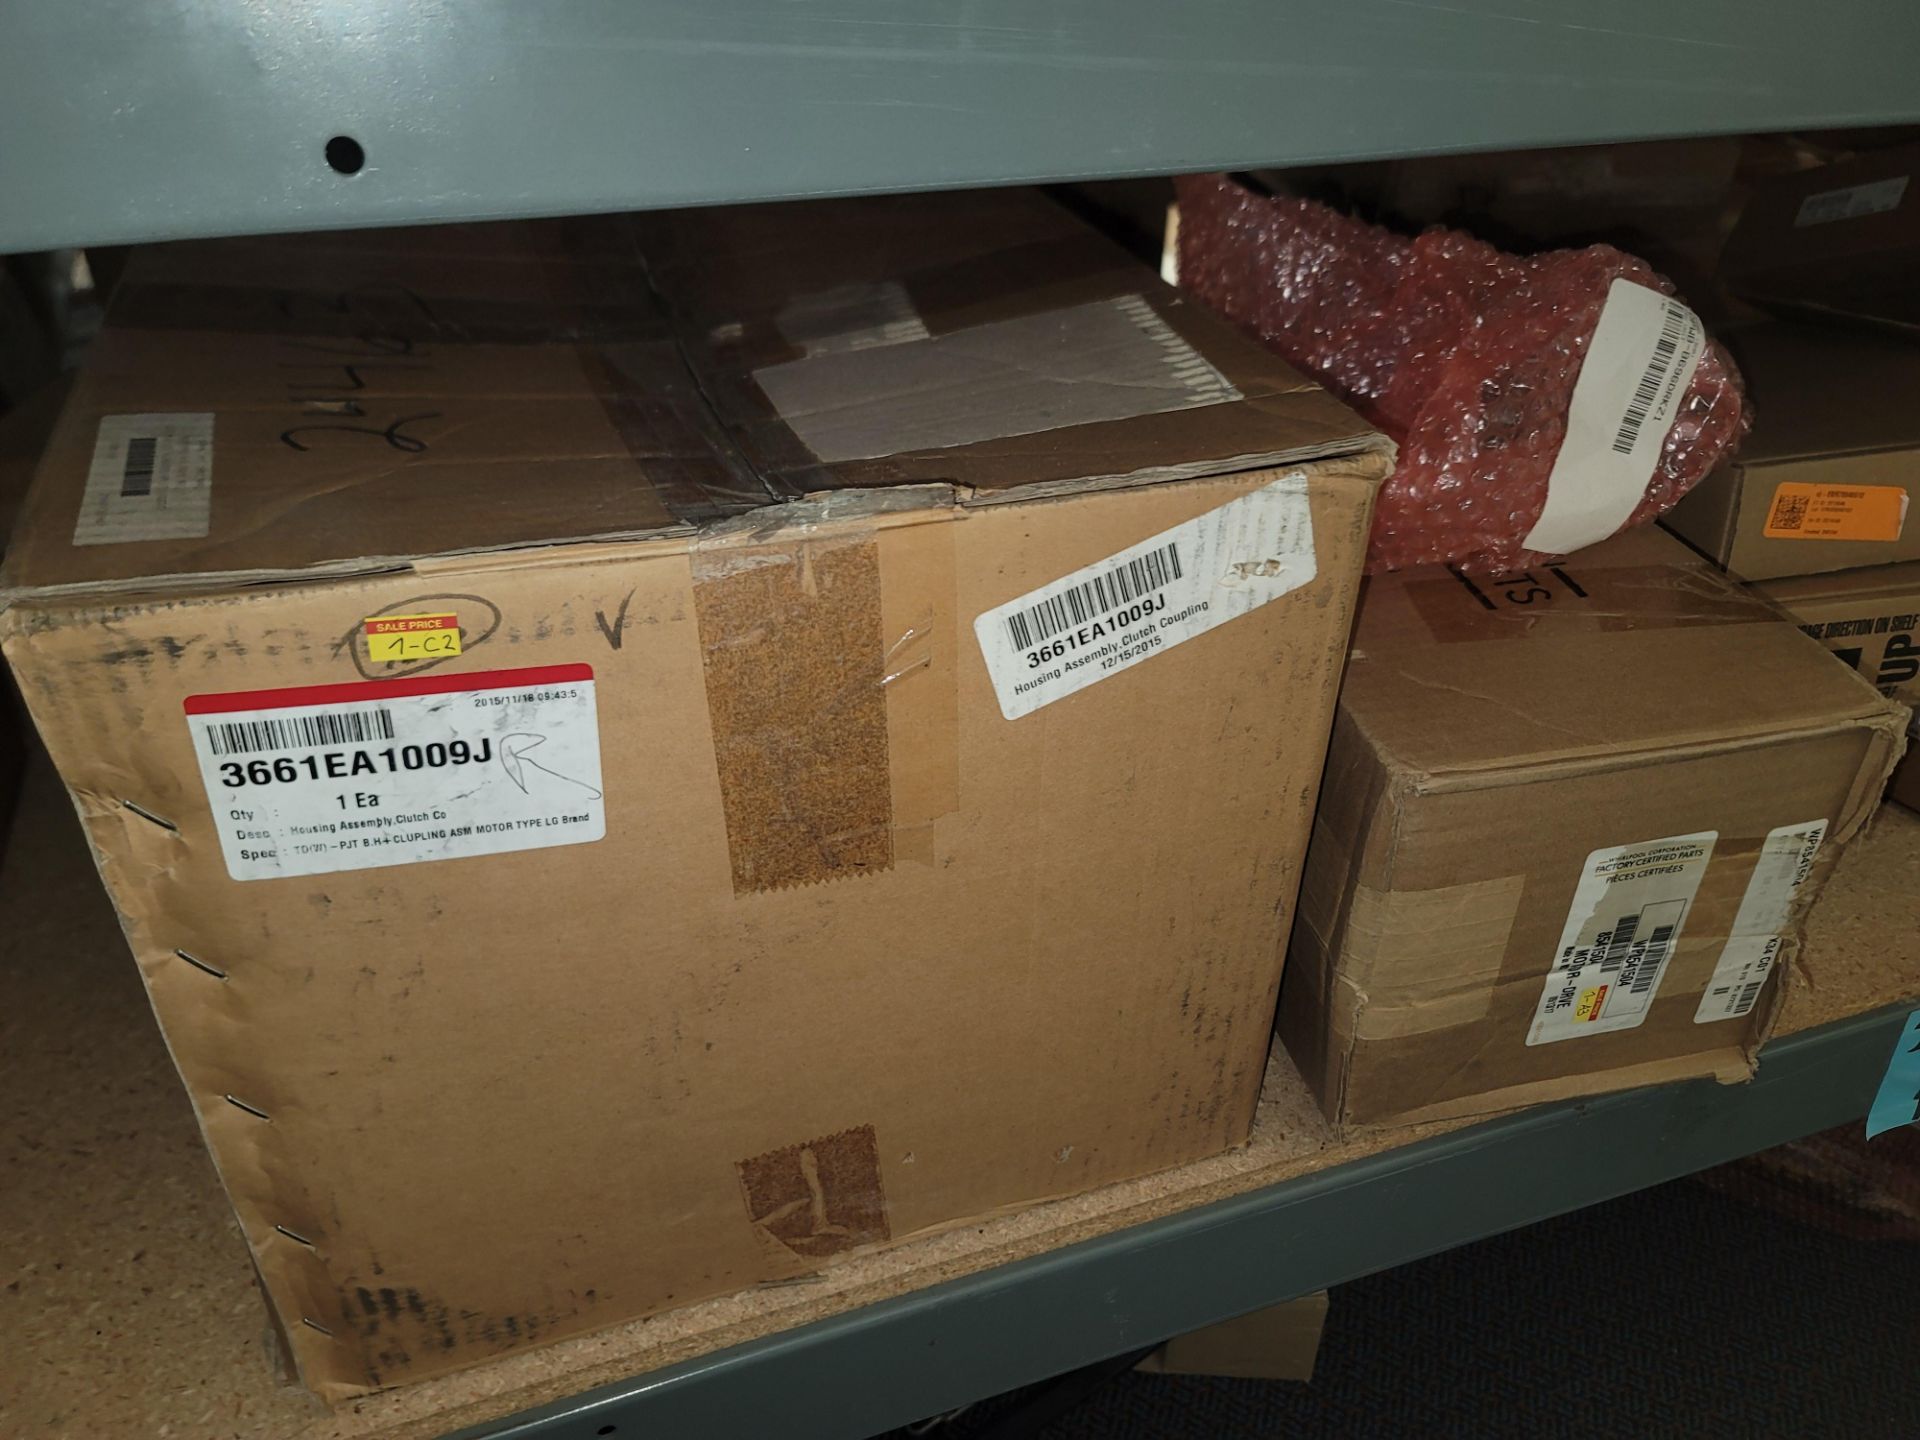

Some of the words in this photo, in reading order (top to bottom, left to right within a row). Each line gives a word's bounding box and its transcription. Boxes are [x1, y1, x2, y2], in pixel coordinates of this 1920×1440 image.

[376, 621, 407, 632] SALE
[408, 619, 443, 630] PRICE
[1027, 593, 1166, 669] 3661EA1009J
[1824, 618, 1875, 639] DIRECTION
[1875, 616, 1890, 634] ON
[1890, 614, 1920, 632] SHELF
[388, 634, 456, 655] 1-C2
[1014, 668, 1061, 696] Housing
[1159, 601, 1209, 628] Coupling
[1101, 635, 1162, 670] 12/15/2015
[1876, 634, 1920, 685] UP
[220, 737, 493, 787] 3661EA1009J
[230, 809, 254, 821] Qty
[336, 794, 347, 810] 1
[355, 792, 380, 808] Ea
[290, 823, 336, 834] Housing
[432, 810, 447, 820] Co
[240, 849, 277, 861] Spec
[450, 827, 472, 838] ASM
[476, 821, 513, 834] MOTOR
[516, 818, 542, 830] TYPE
[545, 816, 558, 826] LG
[562, 813, 590, 824] Brand
[1594, 860, 1637, 873] FACTORY
[1636, 852, 1677, 867] CERTIFIED
[1677, 848, 1705, 860] PARTS
